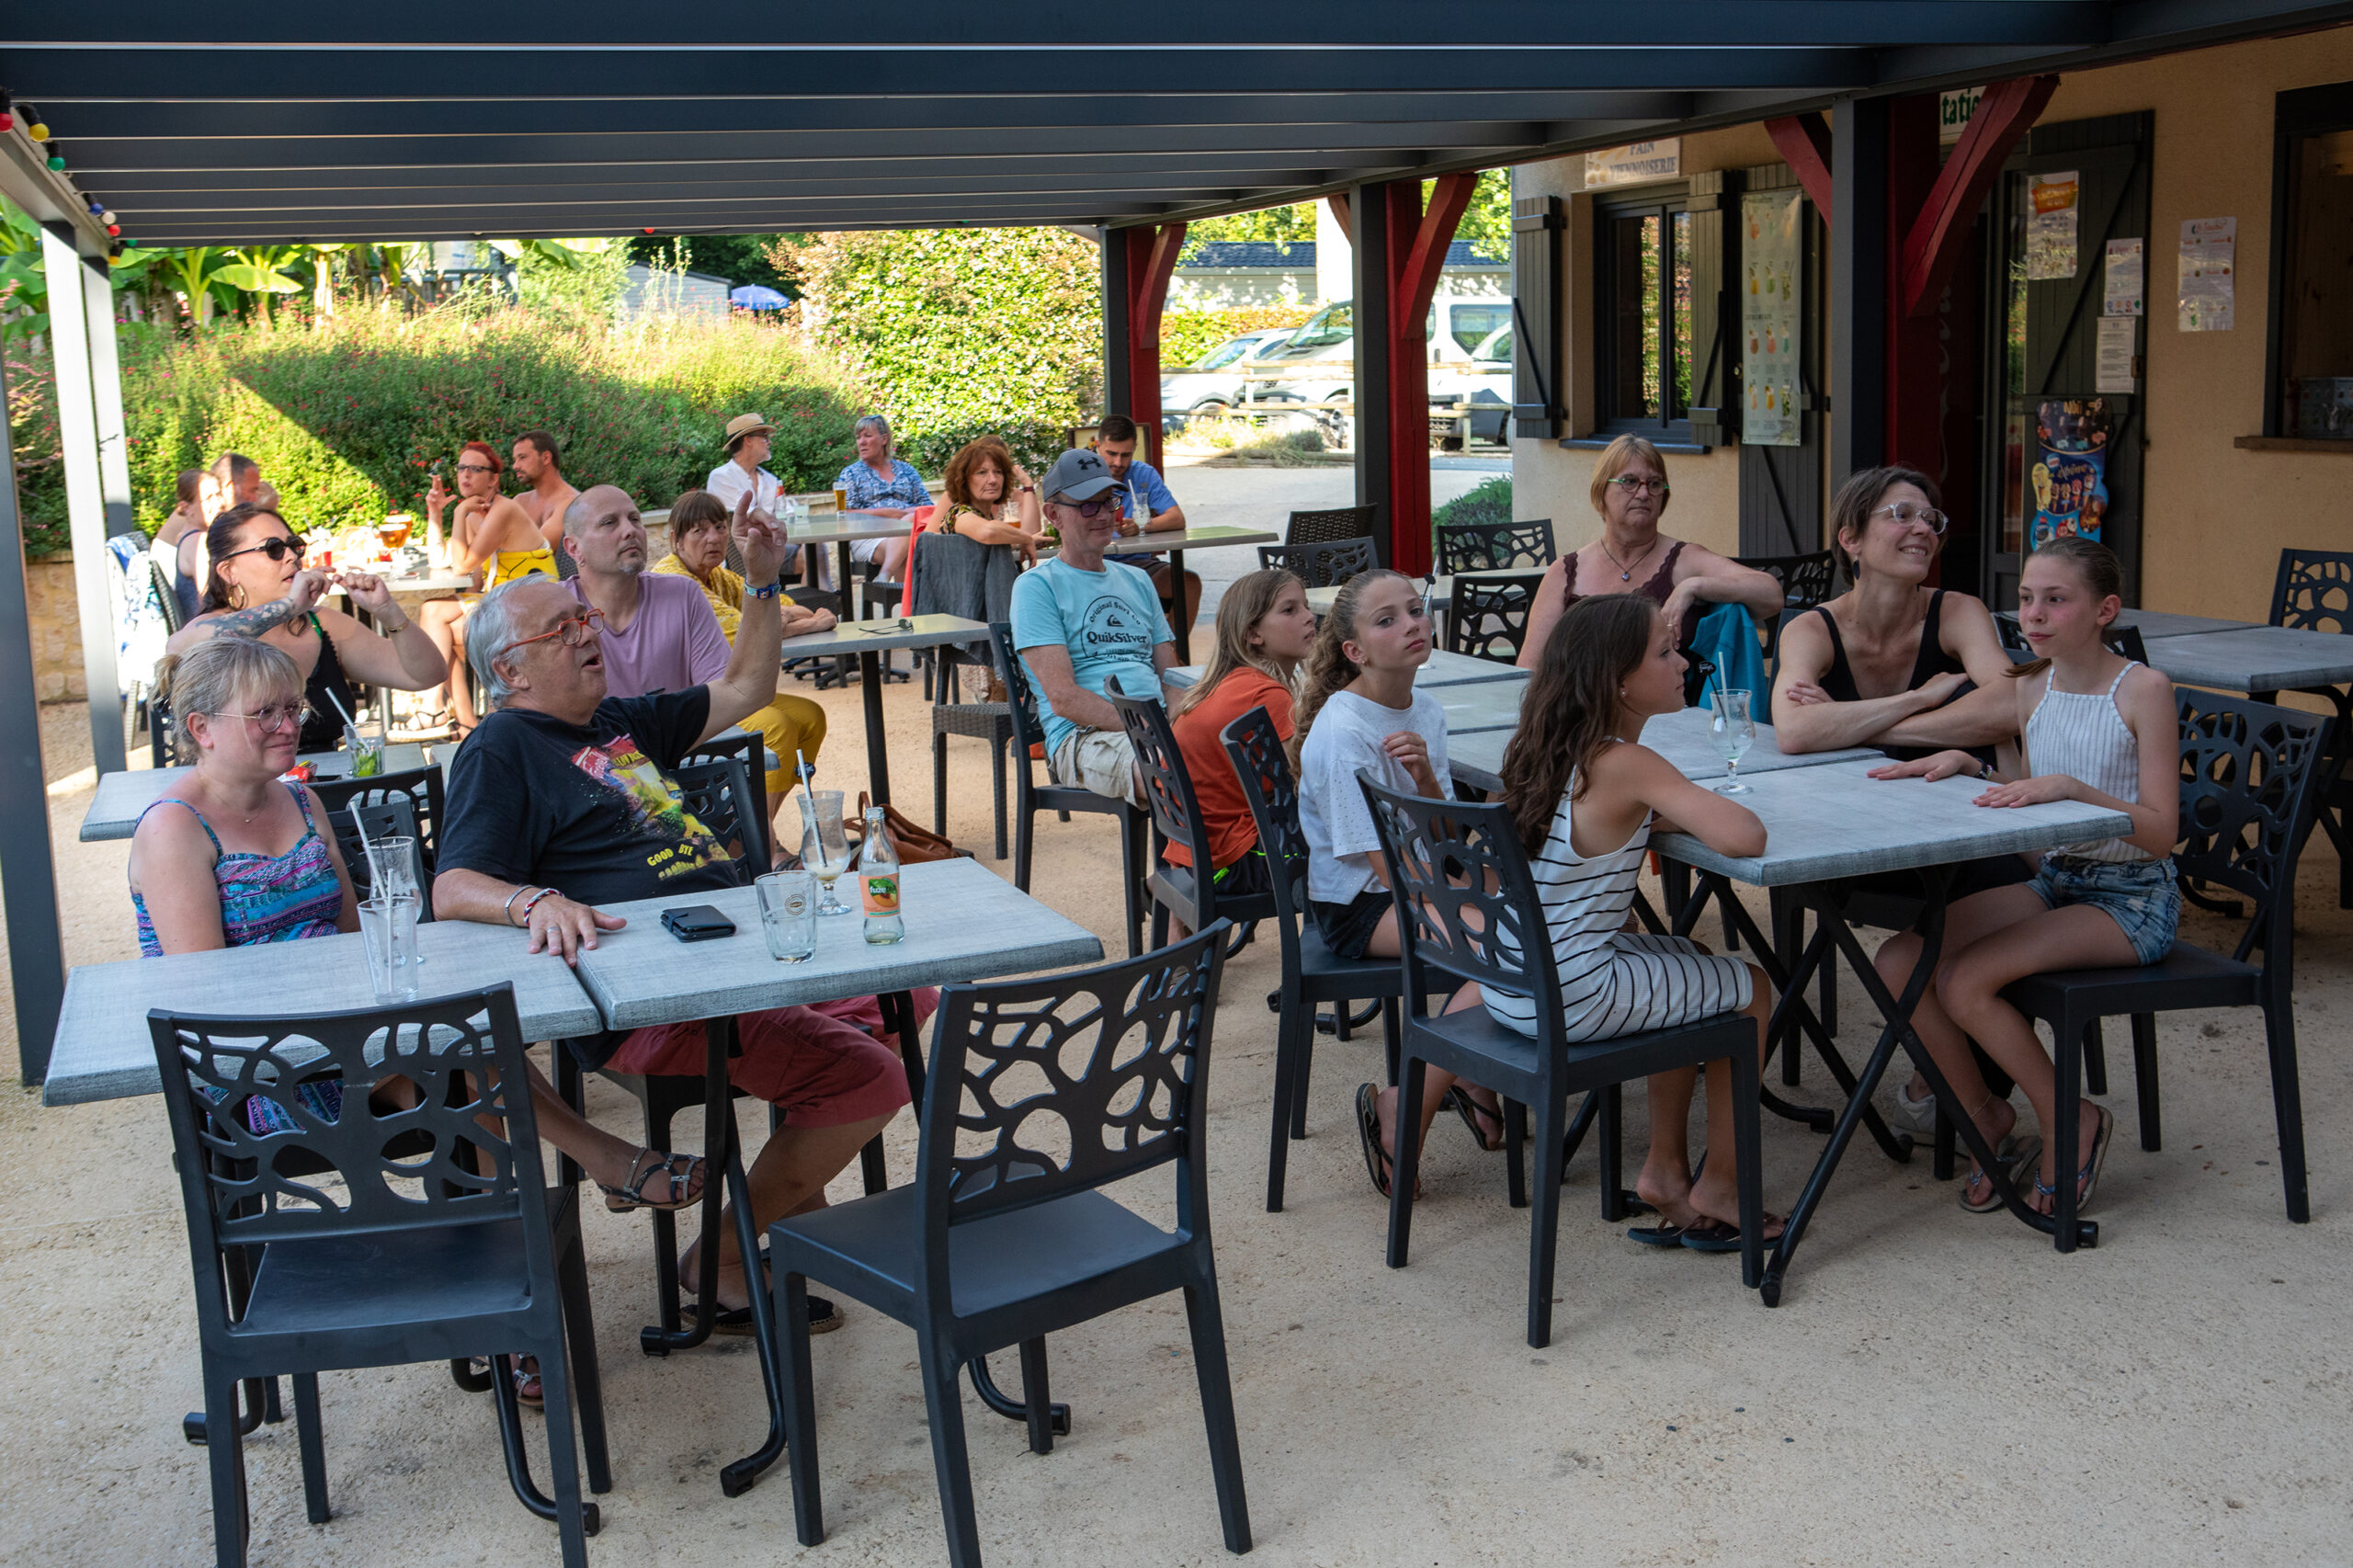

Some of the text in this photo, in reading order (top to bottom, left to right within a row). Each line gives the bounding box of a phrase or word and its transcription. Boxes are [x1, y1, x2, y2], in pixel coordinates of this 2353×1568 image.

[1610, 157, 1677, 179] VIENNOISERIE
[1089, 601, 1113, 623] Original
[646, 843, 693, 867] GOOD BYE
